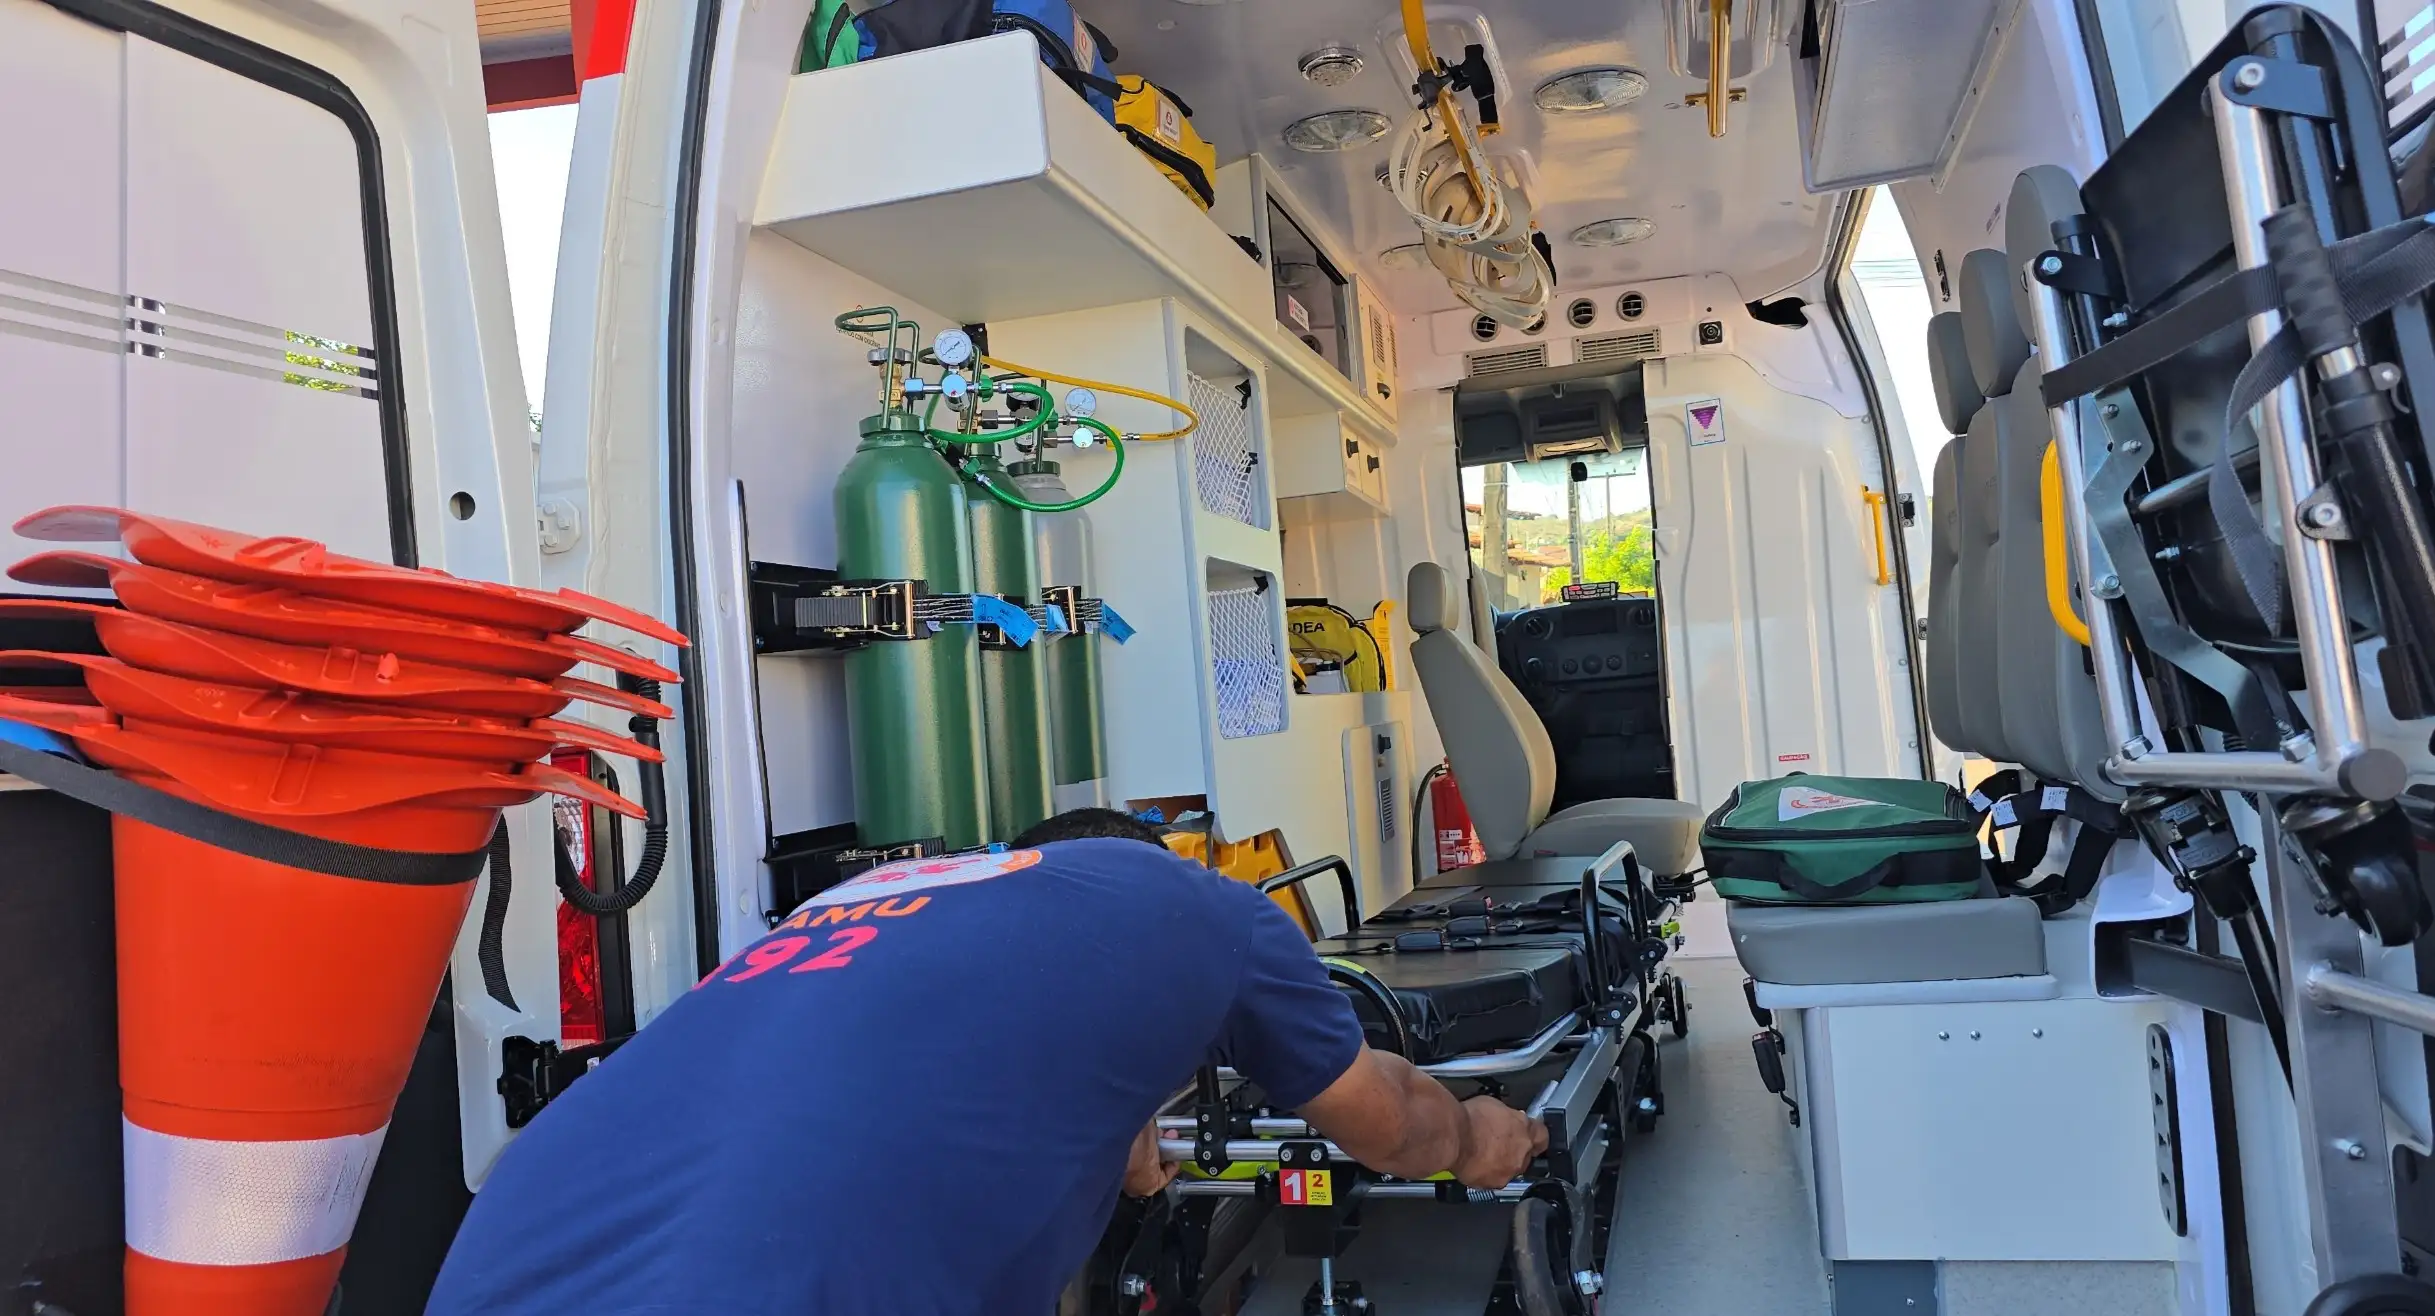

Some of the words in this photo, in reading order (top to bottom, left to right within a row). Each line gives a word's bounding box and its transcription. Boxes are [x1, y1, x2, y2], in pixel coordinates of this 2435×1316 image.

[768, 896, 933, 934] AMU
[1284, 1172, 1302, 1201] 1
[1312, 1173, 1324, 1188] 2
